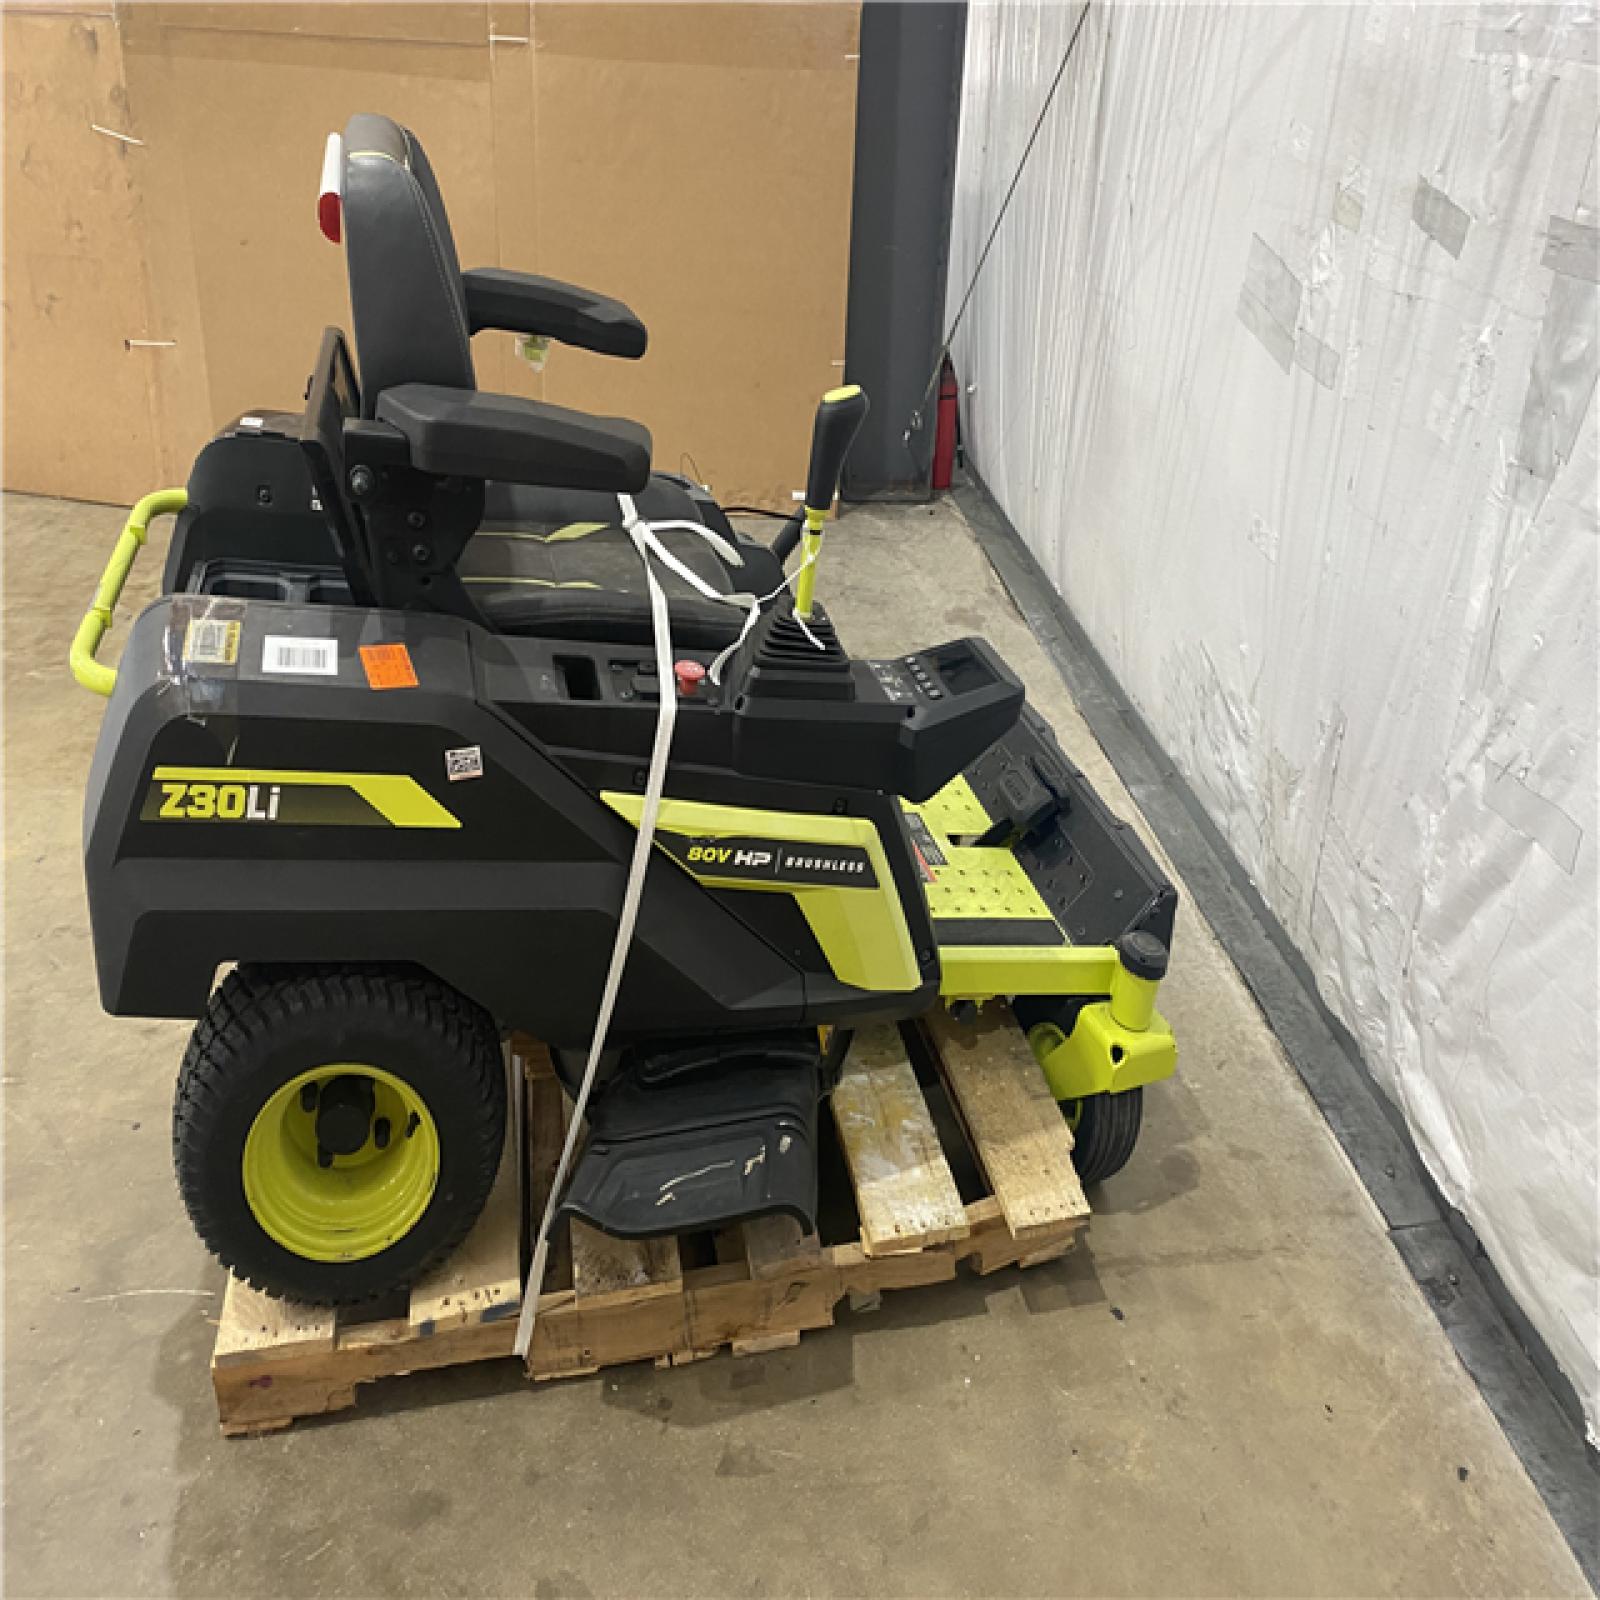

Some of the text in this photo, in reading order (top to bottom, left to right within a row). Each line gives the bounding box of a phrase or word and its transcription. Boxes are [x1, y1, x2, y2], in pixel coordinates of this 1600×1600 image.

[160, 784, 281, 820] Z30Li
[687, 846, 732, 863] 80V
[734, 849, 773, 866] HP
